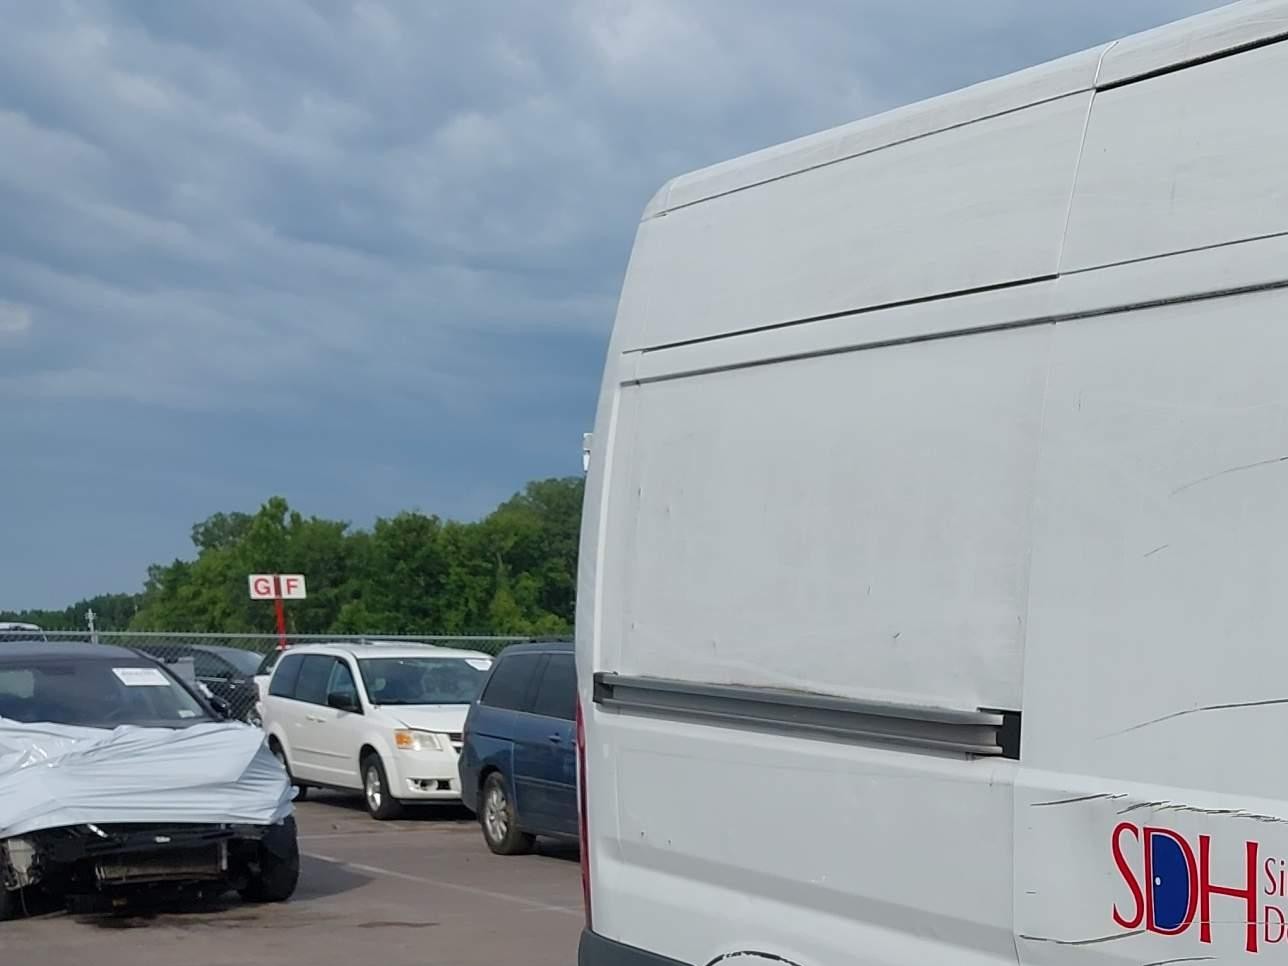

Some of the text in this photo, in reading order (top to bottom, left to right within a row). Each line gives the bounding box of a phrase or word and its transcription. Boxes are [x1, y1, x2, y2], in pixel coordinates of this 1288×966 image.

[254, 578, 298, 595] G F
[1112, 822, 1258, 953] SDH
